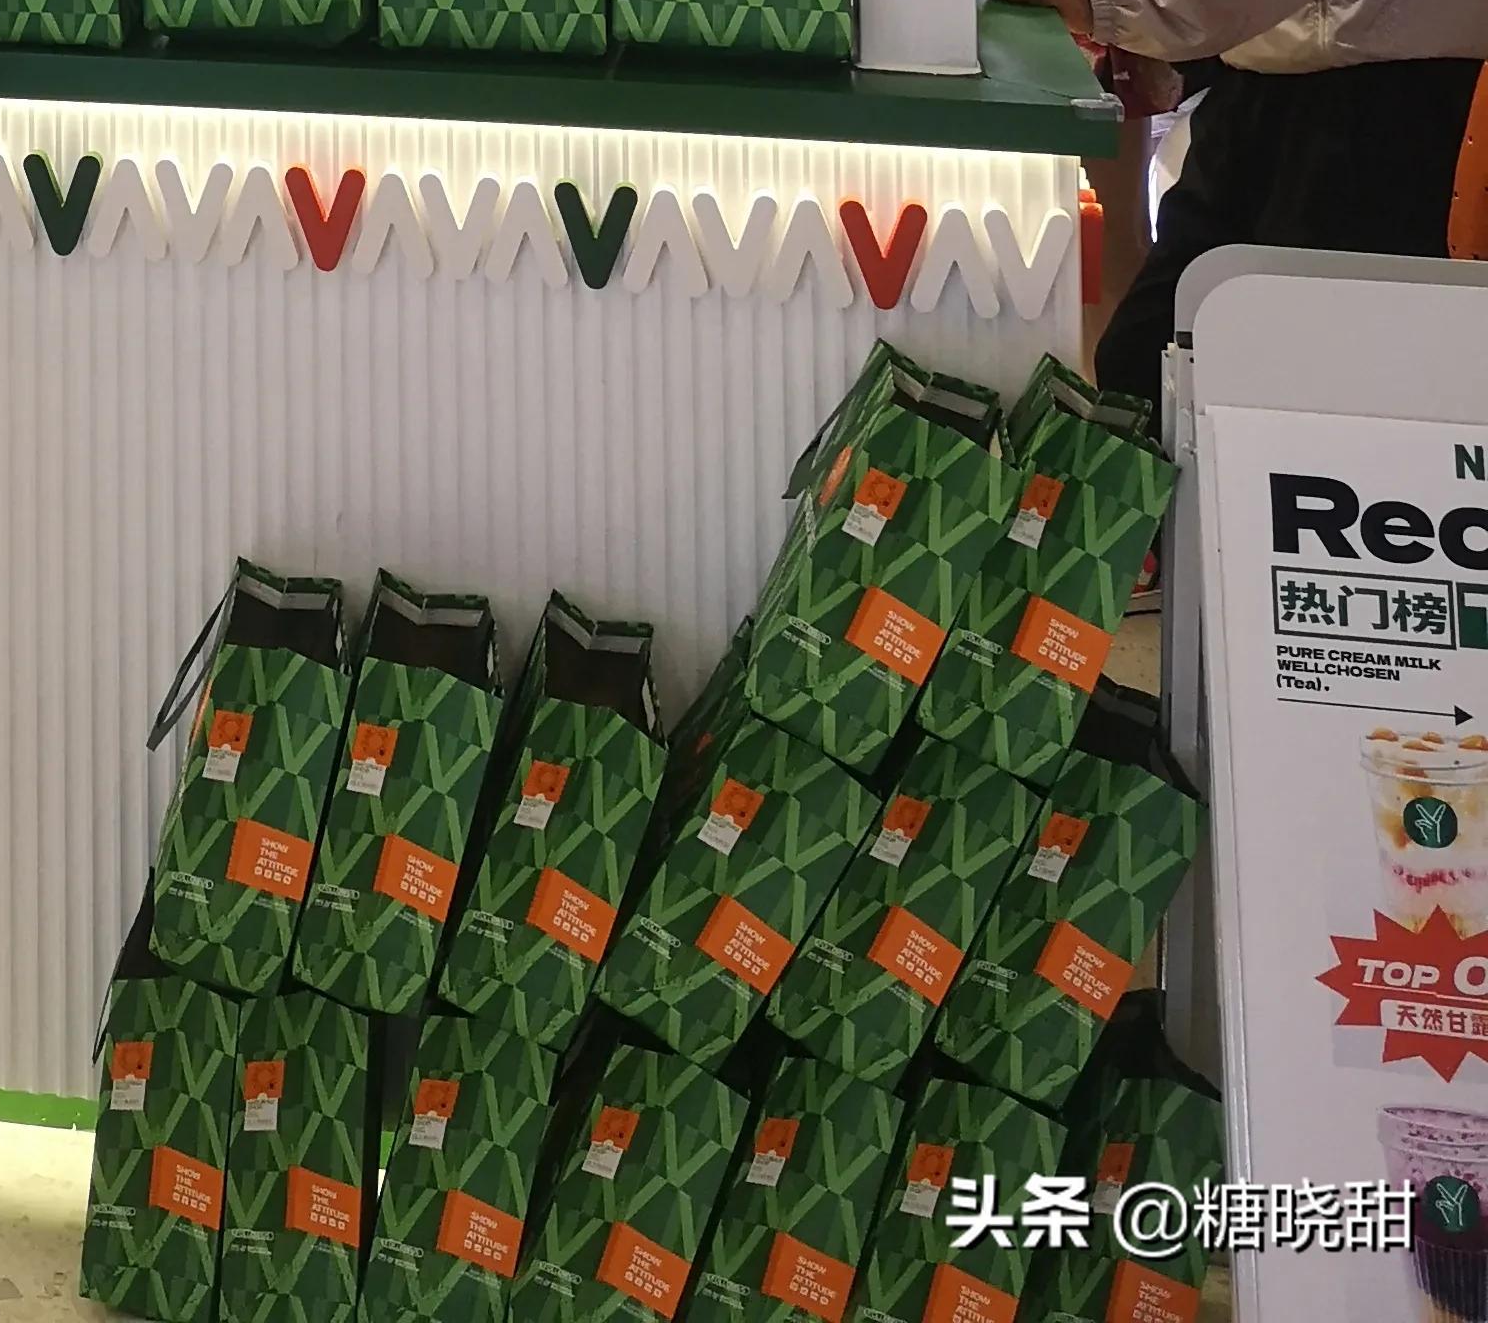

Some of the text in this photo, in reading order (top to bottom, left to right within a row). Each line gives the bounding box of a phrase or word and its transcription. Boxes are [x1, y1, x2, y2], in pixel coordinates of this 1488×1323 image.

[1280, 580, 1447, 636] 热门榜
[883, 619, 904, 636] THE
[1047, 627, 1067, 643] THE
[879, 628, 921, 660] ATTITUDE
[1042, 637, 1088, 665] ATTITUDE
[1276, 645, 1442, 671] PURE CREAM MILK
[1277, 659, 1401, 681] WELLCHOSEN
[260, 847, 279, 860] THE
[257, 856, 300, 878] ATTITUDE
[406, 864, 425, 878] THE
[561, 899, 580, 915] THE
[735, 930, 754, 948] THE
[906, 940, 926, 957] THE
[1072, 955, 1093, 973] THE
[1357, 958, 1440, 989] TOP
[468, 1221, 489, 1237] THE
